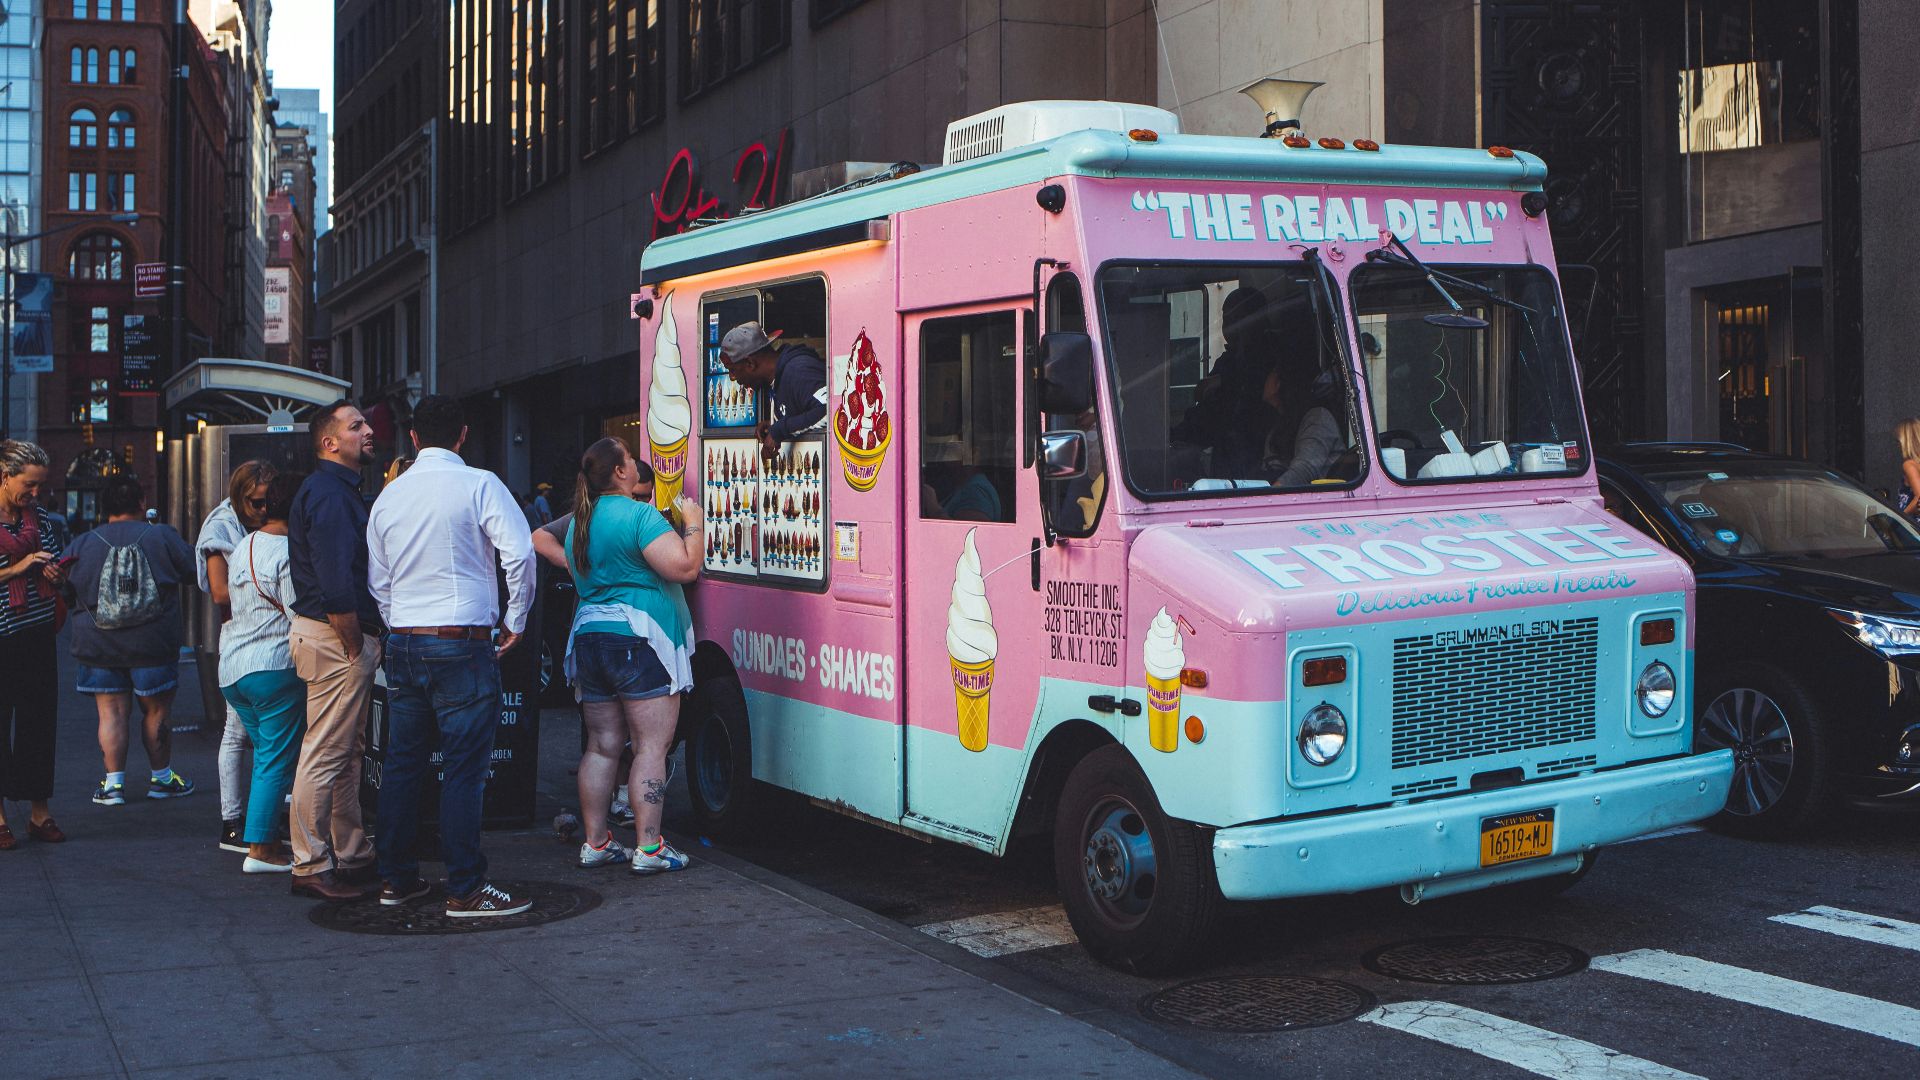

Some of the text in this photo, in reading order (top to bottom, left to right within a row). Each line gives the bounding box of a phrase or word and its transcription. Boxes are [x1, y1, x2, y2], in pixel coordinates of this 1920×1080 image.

[1262, 193, 1379, 243] REAL
[653, 450, 685, 475] FUN-TIME
[845, 457, 878, 479] FUN-TIME
[1233, 522, 1659, 590] FROSTEE
[1046, 580, 1122, 612] SMOOTHIE INC.
[1336, 568, 1637, 616] Delicious Frostee Treats
[1044, 607, 1126, 640] 328 TEN-EYCK ST.
[1435, 619, 1560, 646] GRUMMAN OLSON
[732, 628, 896, 702] SUNDAES SHAKES
[1050, 635, 1118, 667] BK. N.Y. 11206
[953, 666, 991, 690] FUN-TIME
[1147, 683, 1179, 701] FUN-TIME
[502, 691, 523, 706] ALE
[364, 755, 383, 790] TRAS
[1500, 814, 1537, 827] NEW YORK
[1489, 827, 1525, 857] 16519
[1498, 850, 1537, 862] COMMERCIAL
